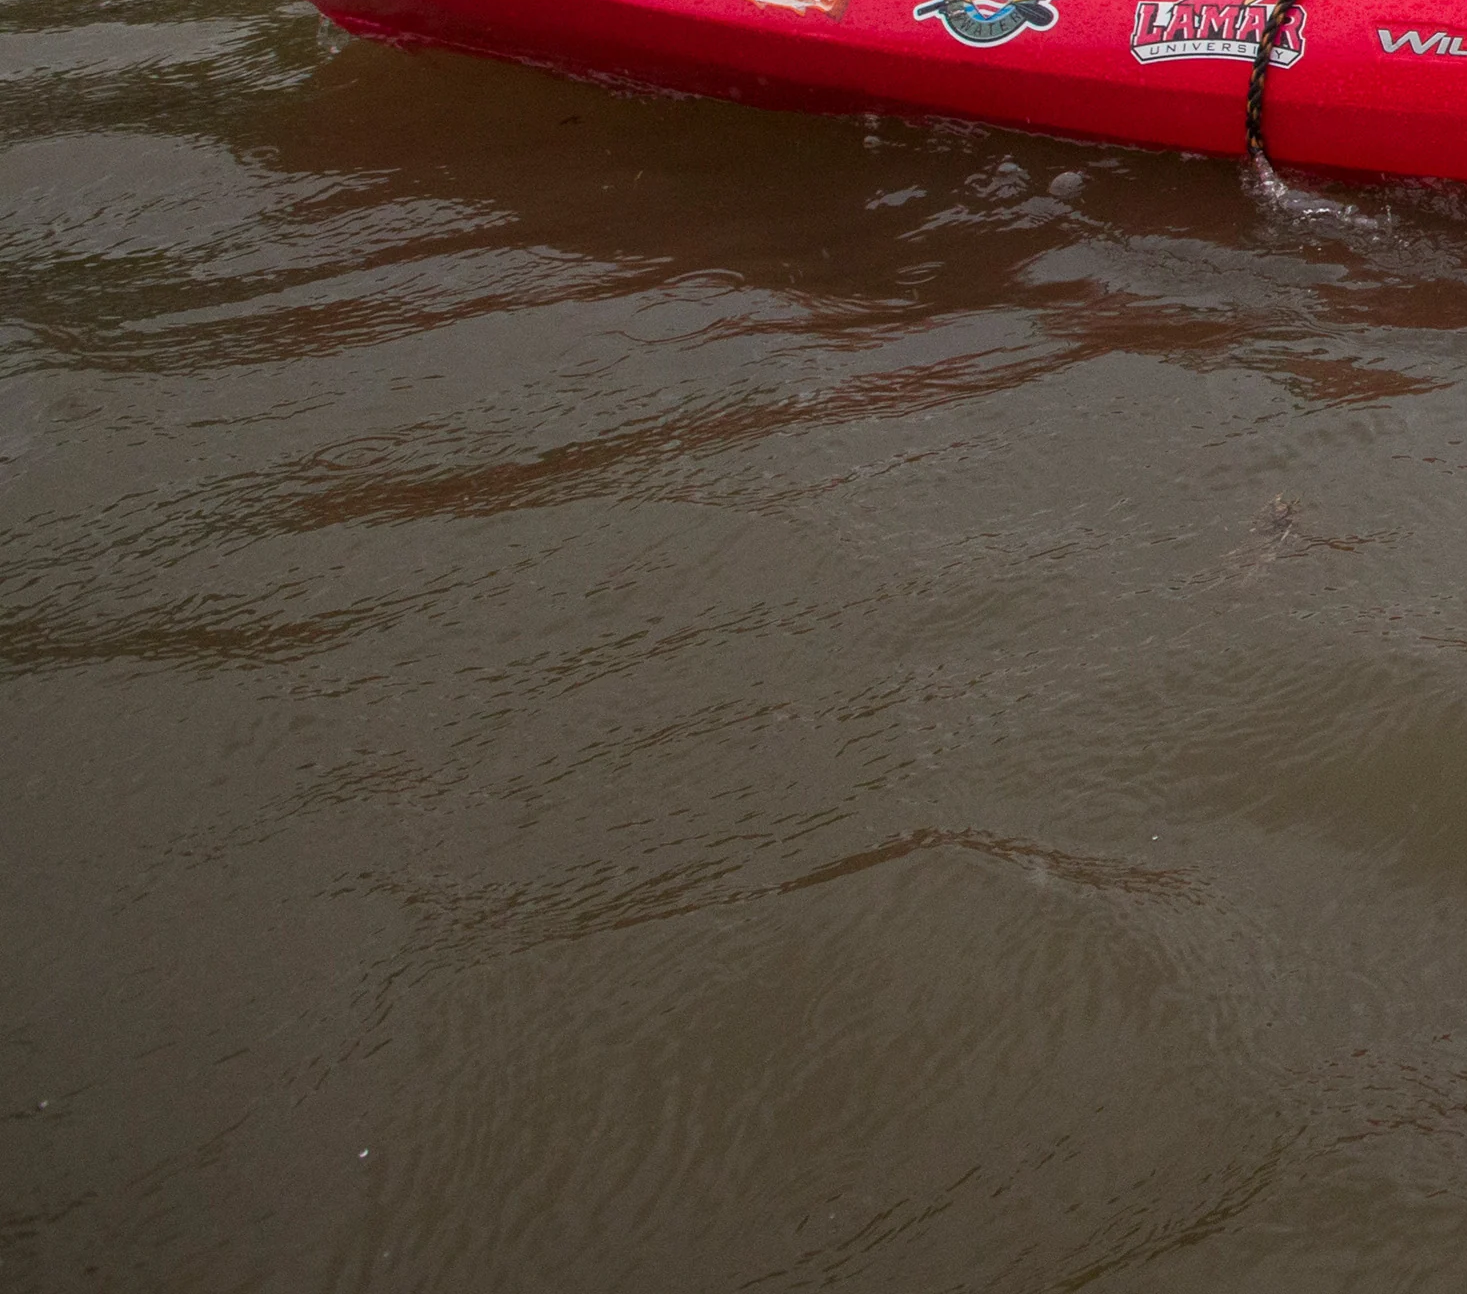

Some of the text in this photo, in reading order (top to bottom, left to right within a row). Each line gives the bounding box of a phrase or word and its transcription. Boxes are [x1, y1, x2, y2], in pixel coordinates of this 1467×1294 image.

[959, 10, 1023, 37] WATER
[1134, 3, 1302, 51] LAMAR
[1150, 41, 1285, 60] UNIVERSIY
